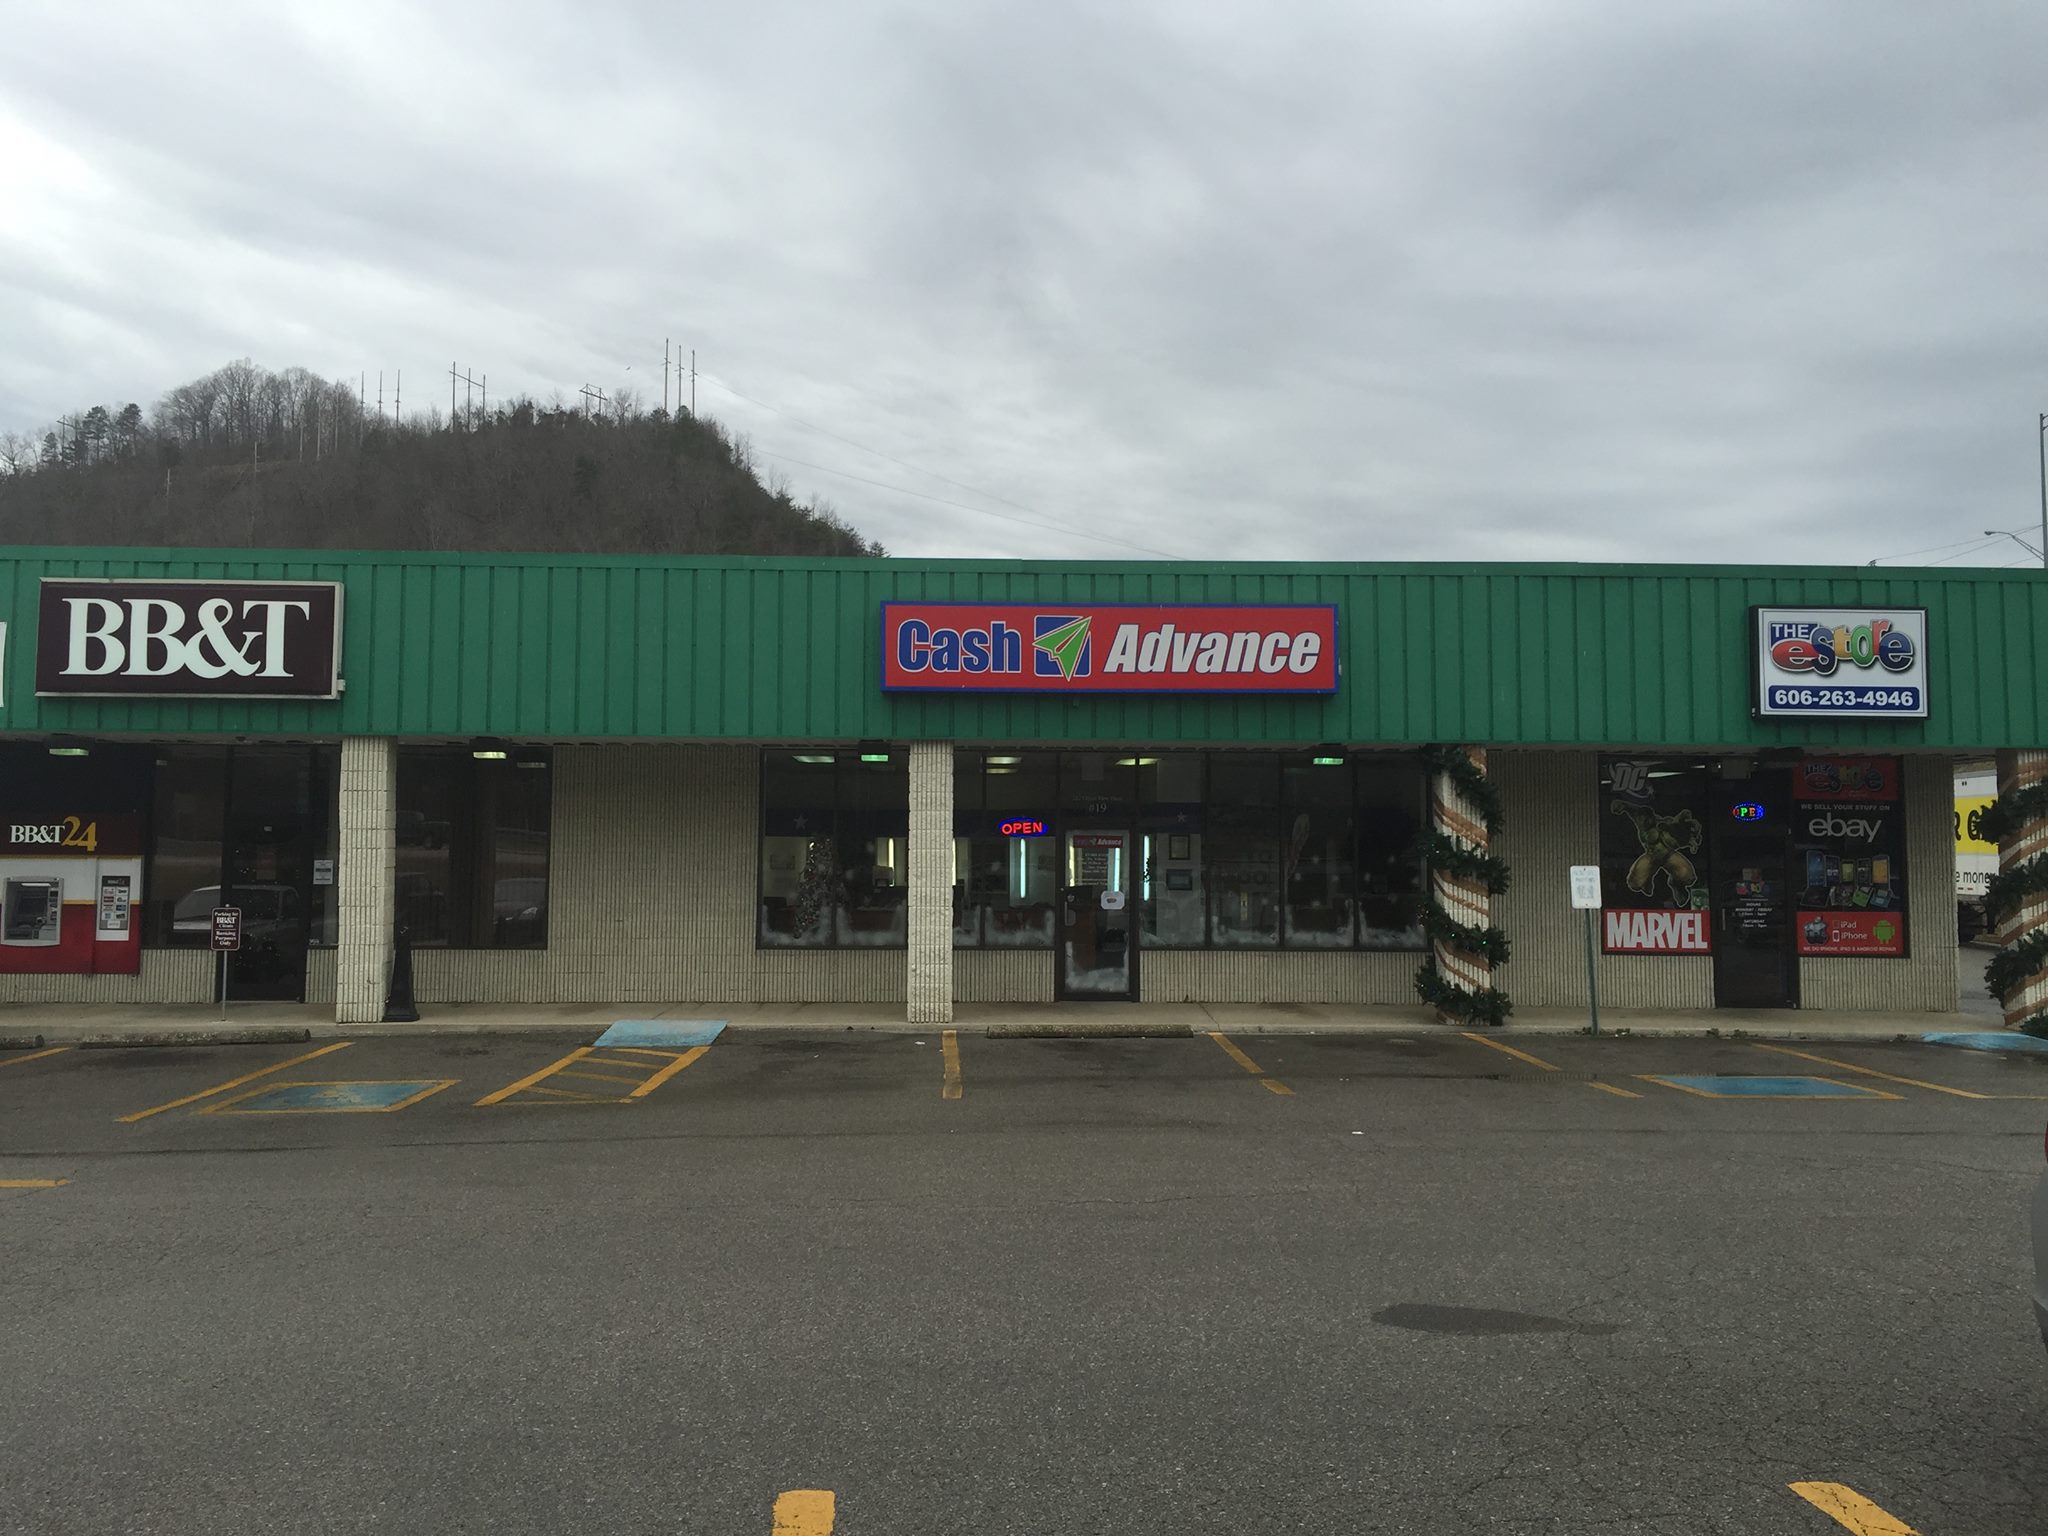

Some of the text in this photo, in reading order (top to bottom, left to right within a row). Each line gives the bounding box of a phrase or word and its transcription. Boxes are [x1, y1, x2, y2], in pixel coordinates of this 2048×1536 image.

[59, 598, 310, 679] BB&T
[1772, 624, 1809, 638] THE
[897, 619, 1321, 674] Cash Advance
[1775, 690, 1913, 707] 606-263-4946
[1613, 766, 1648, 791] DC
[1001, 820, 1043, 836] OPEN
[1808, 812, 1882, 843] ebay
[1607, 911, 1708, 949] MARVEL
[1840, 921, 1857, 929] iPad
[1841, 931, 1868, 940] iPhone
